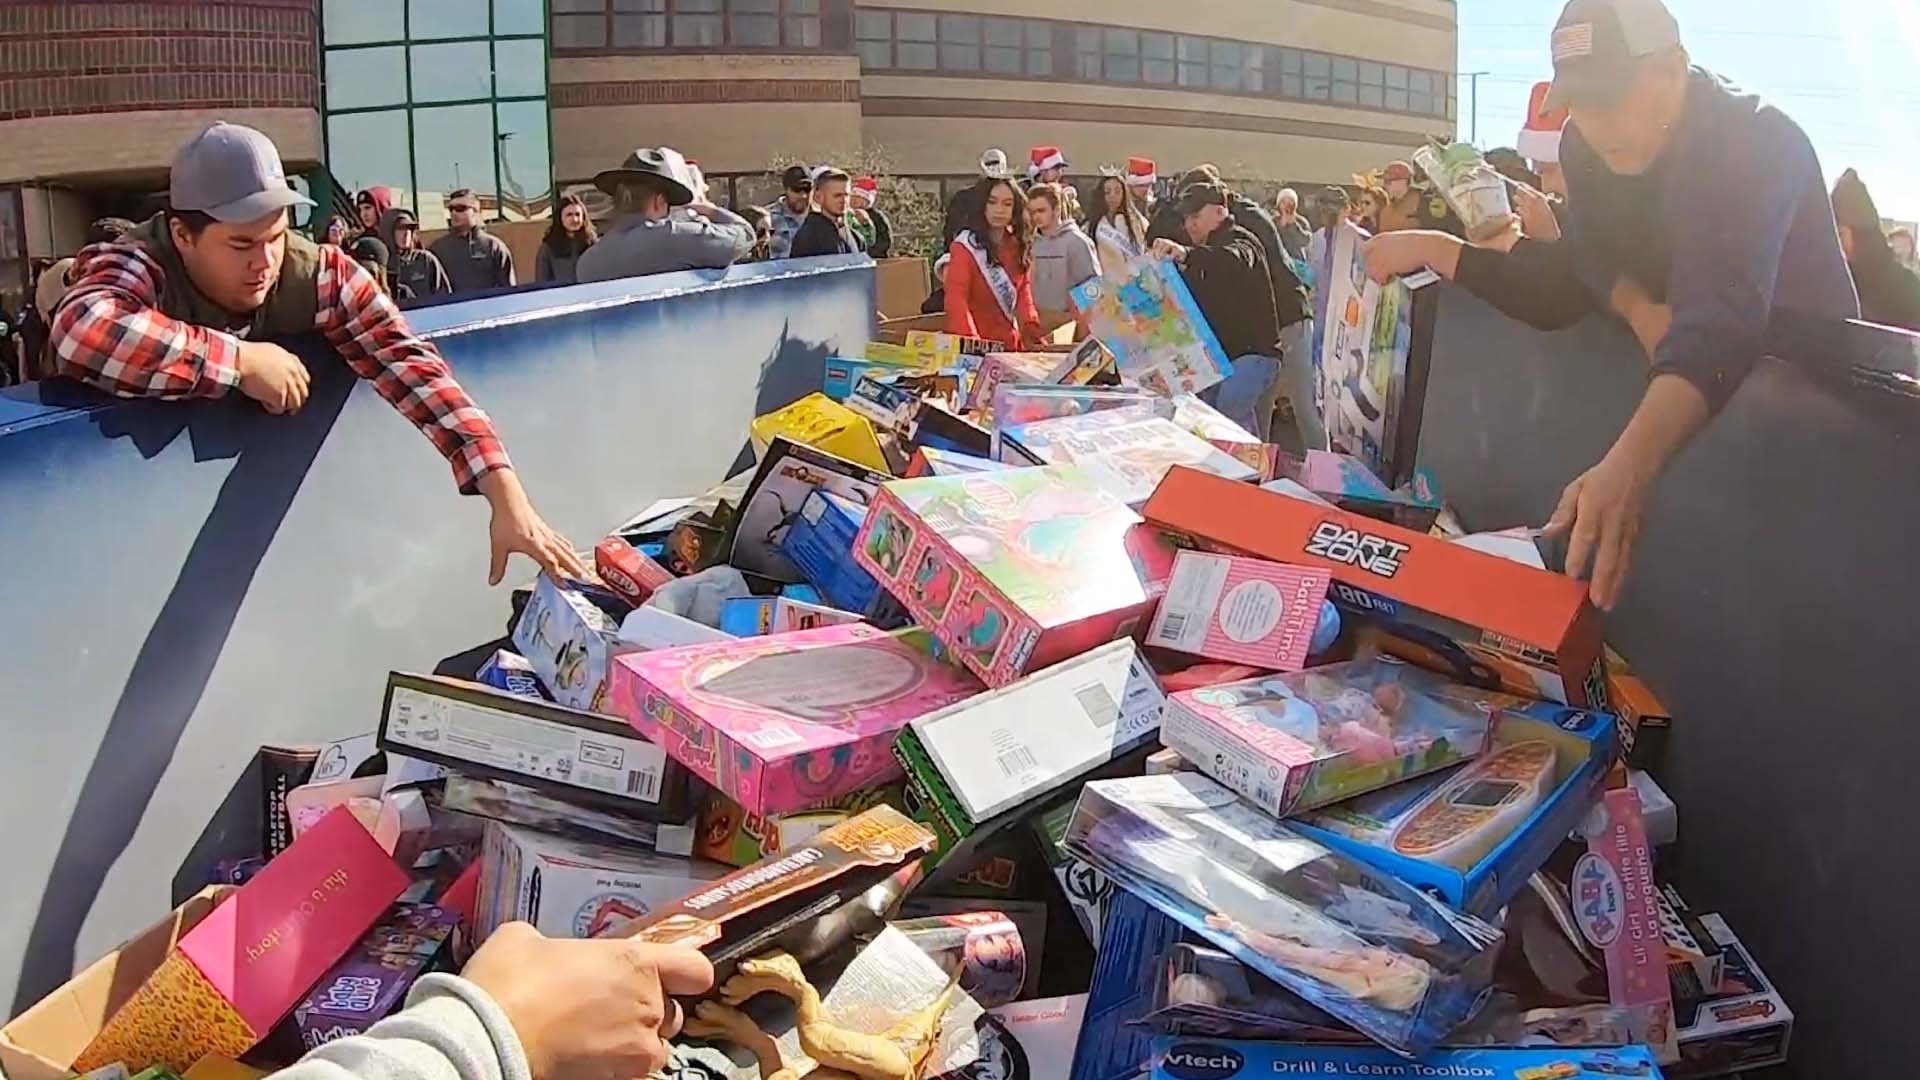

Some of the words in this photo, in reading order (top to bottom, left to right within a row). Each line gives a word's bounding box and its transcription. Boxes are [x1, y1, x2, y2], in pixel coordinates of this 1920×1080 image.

[1314, 521, 1411, 560] DART
[1304, 536, 1399, 577] ZONE
[1164, 1049, 1241, 1070] vtech
[1272, 1059, 1317, 1074] Drill
[1324, 1060, 1339, 1074] &
[1344, 1061, 1406, 1076] Learn
[1412, 1062, 1496, 1078] Toolbox
